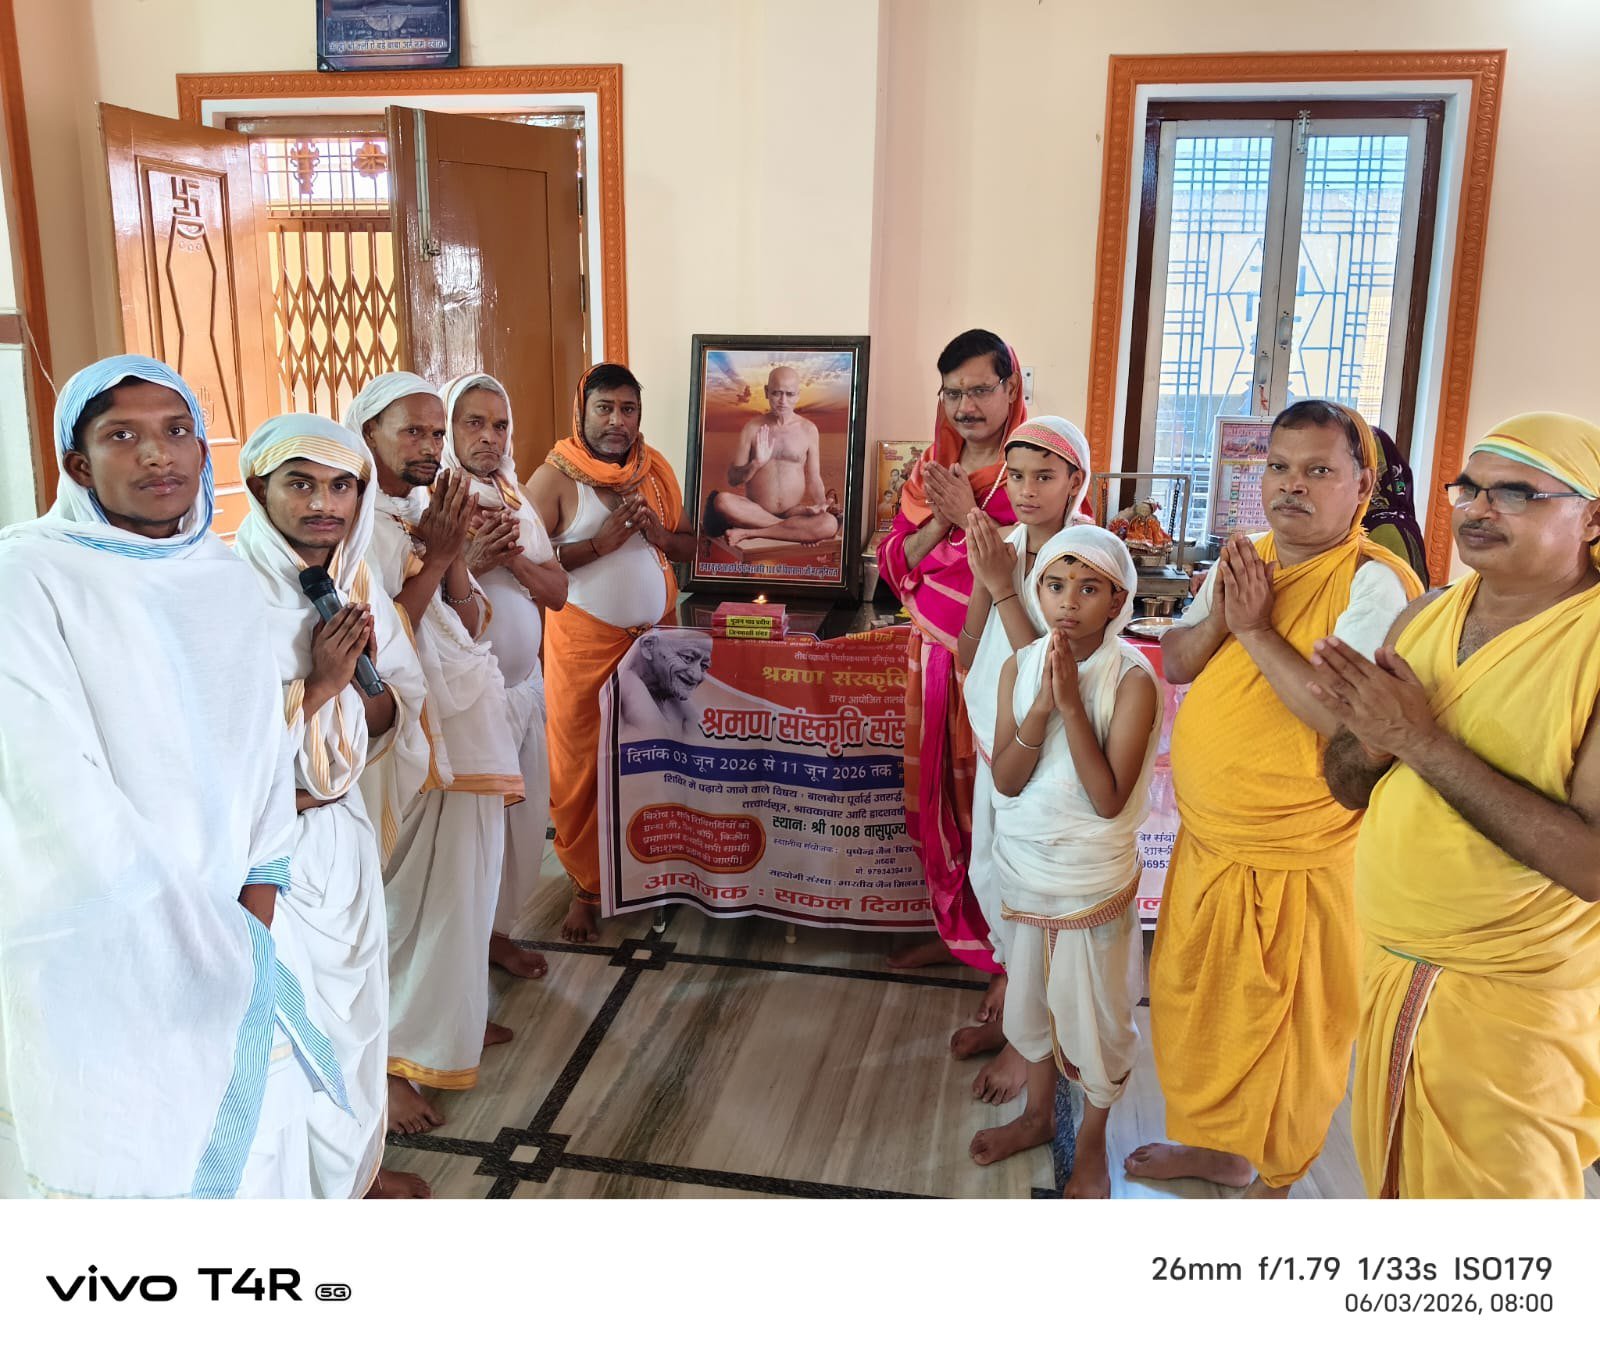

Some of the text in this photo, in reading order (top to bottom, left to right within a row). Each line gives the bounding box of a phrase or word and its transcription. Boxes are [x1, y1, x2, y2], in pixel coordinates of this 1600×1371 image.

[762, 666, 824, 685] श्रमण
[701, 707, 773, 740] श्रमण
[776, 706, 868, 757] संस्कृति
[626, 745, 671, 764] दिनांक
[673, 750, 688, 764] 03
[691, 754, 715, 773] जून
[719, 758, 757, 771] 2026
[763, 755, 776, 772] से
[782, 761, 797, 775] 11
[803, 763, 828, 782] जून
[832, 765, 866, 780] 2026
[870, 763, 894, 777] तक
[726, 784, 748, 795] जाने
[751, 784, 770, 794] वाले
[773, 785, 798, 798] विषय
[846, 808, 867, 819] आदि
[811, 818, 827, 835] श्री
[830, 824, 860, 838] 1008
[864, 822, 907, 841] वासुपूज्य
[769, 869, 804, 881] सहयोगी
[805, 874, 832, 886] संस्था
[838, 879, 873, 889] भारतीय
[875, 879, 892, 889] जैन
[893, 879, 918, 889] मिलन
[644, 872, 750, 900] आयोजक
[774, 887, 853, 912] सकल
